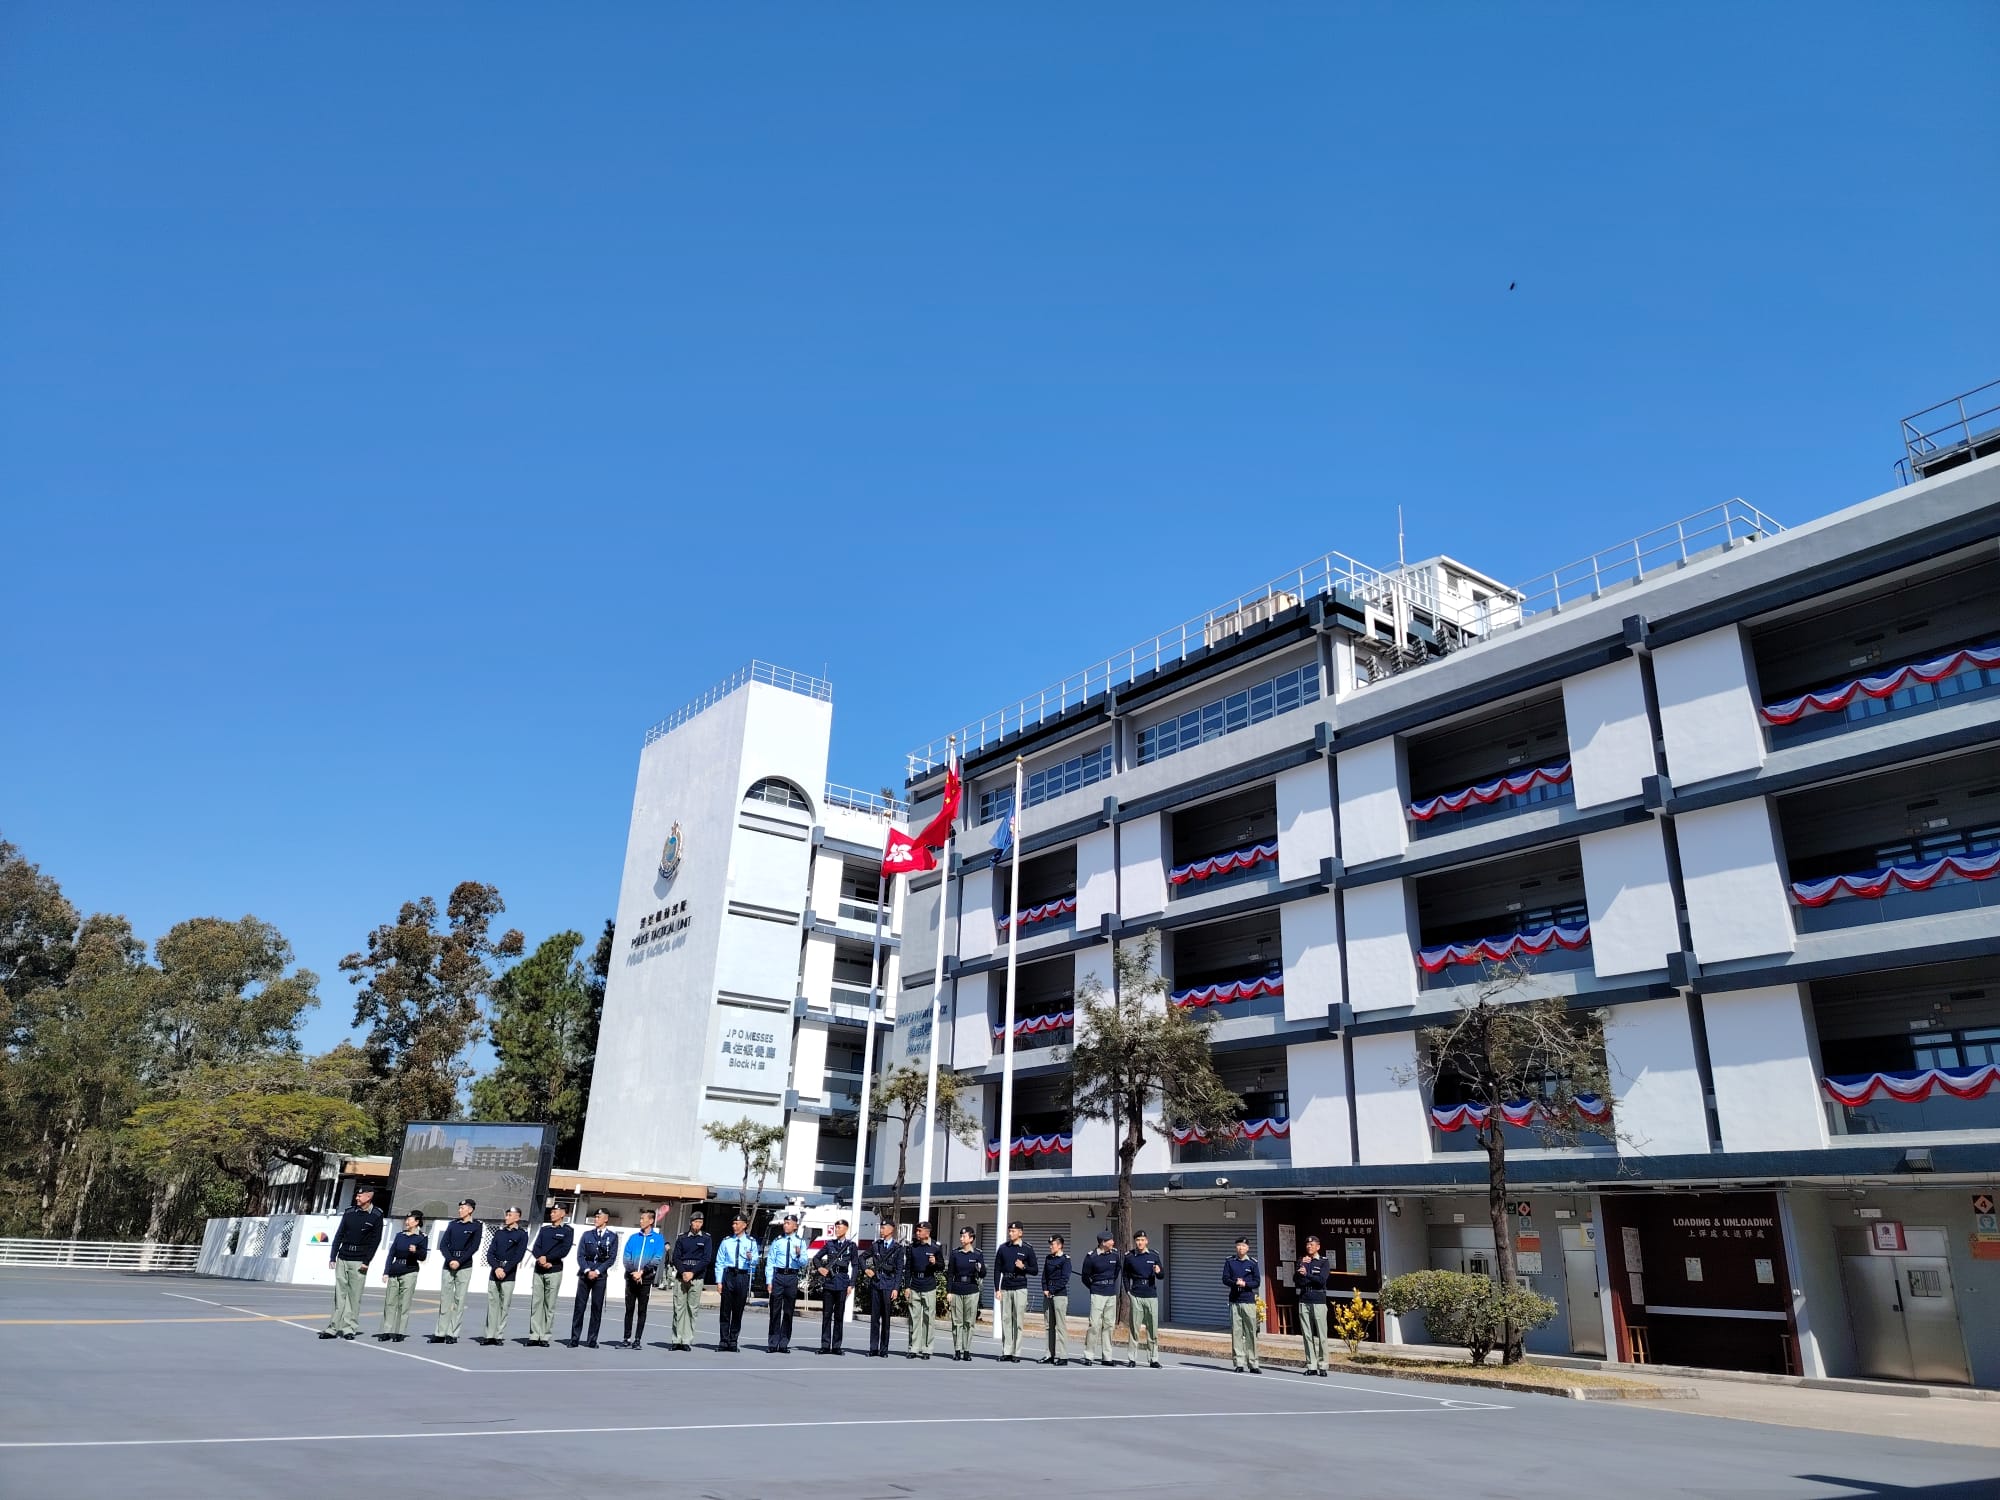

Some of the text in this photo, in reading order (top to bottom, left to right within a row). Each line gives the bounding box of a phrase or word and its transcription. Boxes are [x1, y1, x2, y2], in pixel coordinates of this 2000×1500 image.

[630, 932, 649, 949] POLICE
[677, 915, 692, 931] UNIT
[745, 1031, 774, 1043] MESSES
[729, 1057, 749, 1069] Block
[1673, 1218, 1711, 1227] LOADING
[1713, 1218, 1721, 1227] &
